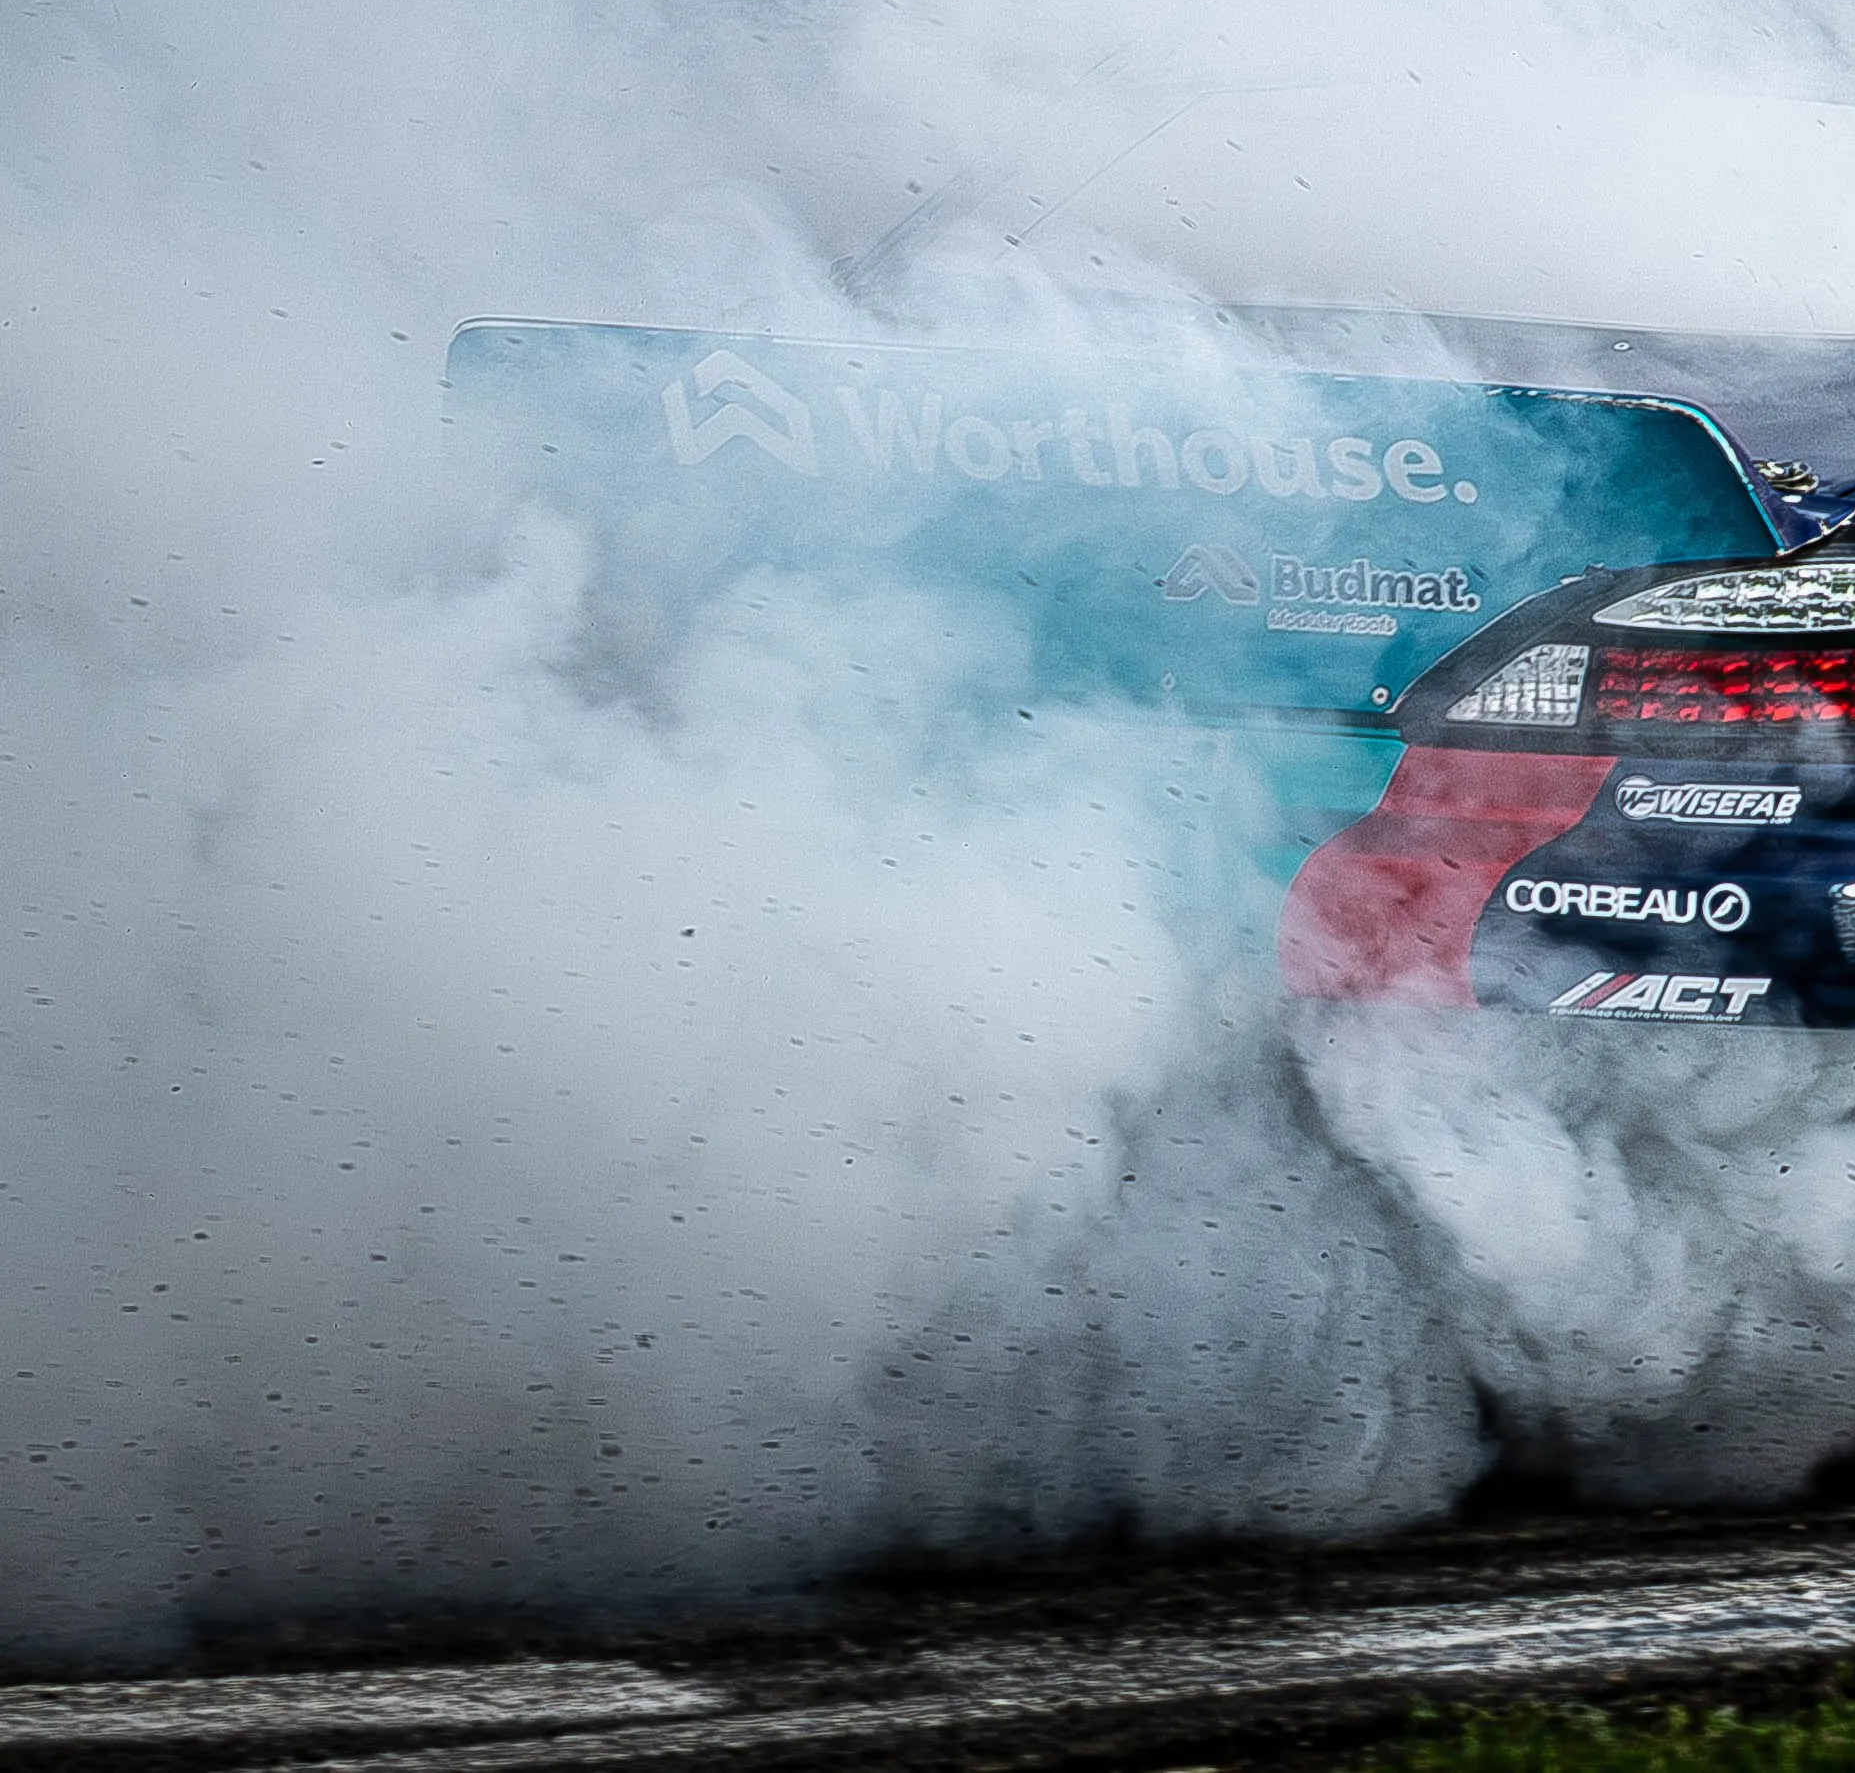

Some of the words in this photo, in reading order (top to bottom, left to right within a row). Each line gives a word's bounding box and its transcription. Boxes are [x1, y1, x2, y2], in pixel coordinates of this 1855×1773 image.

[834, 382, 1480, 506] Worthouse.
[1271, 554, 1482, 613] Budmat.
[1659, 790, 1802, 818] WISEFAB
[1506, 880, 1697, 923] CORBEAU
[1595, 974, 1772, 1014] ACT
